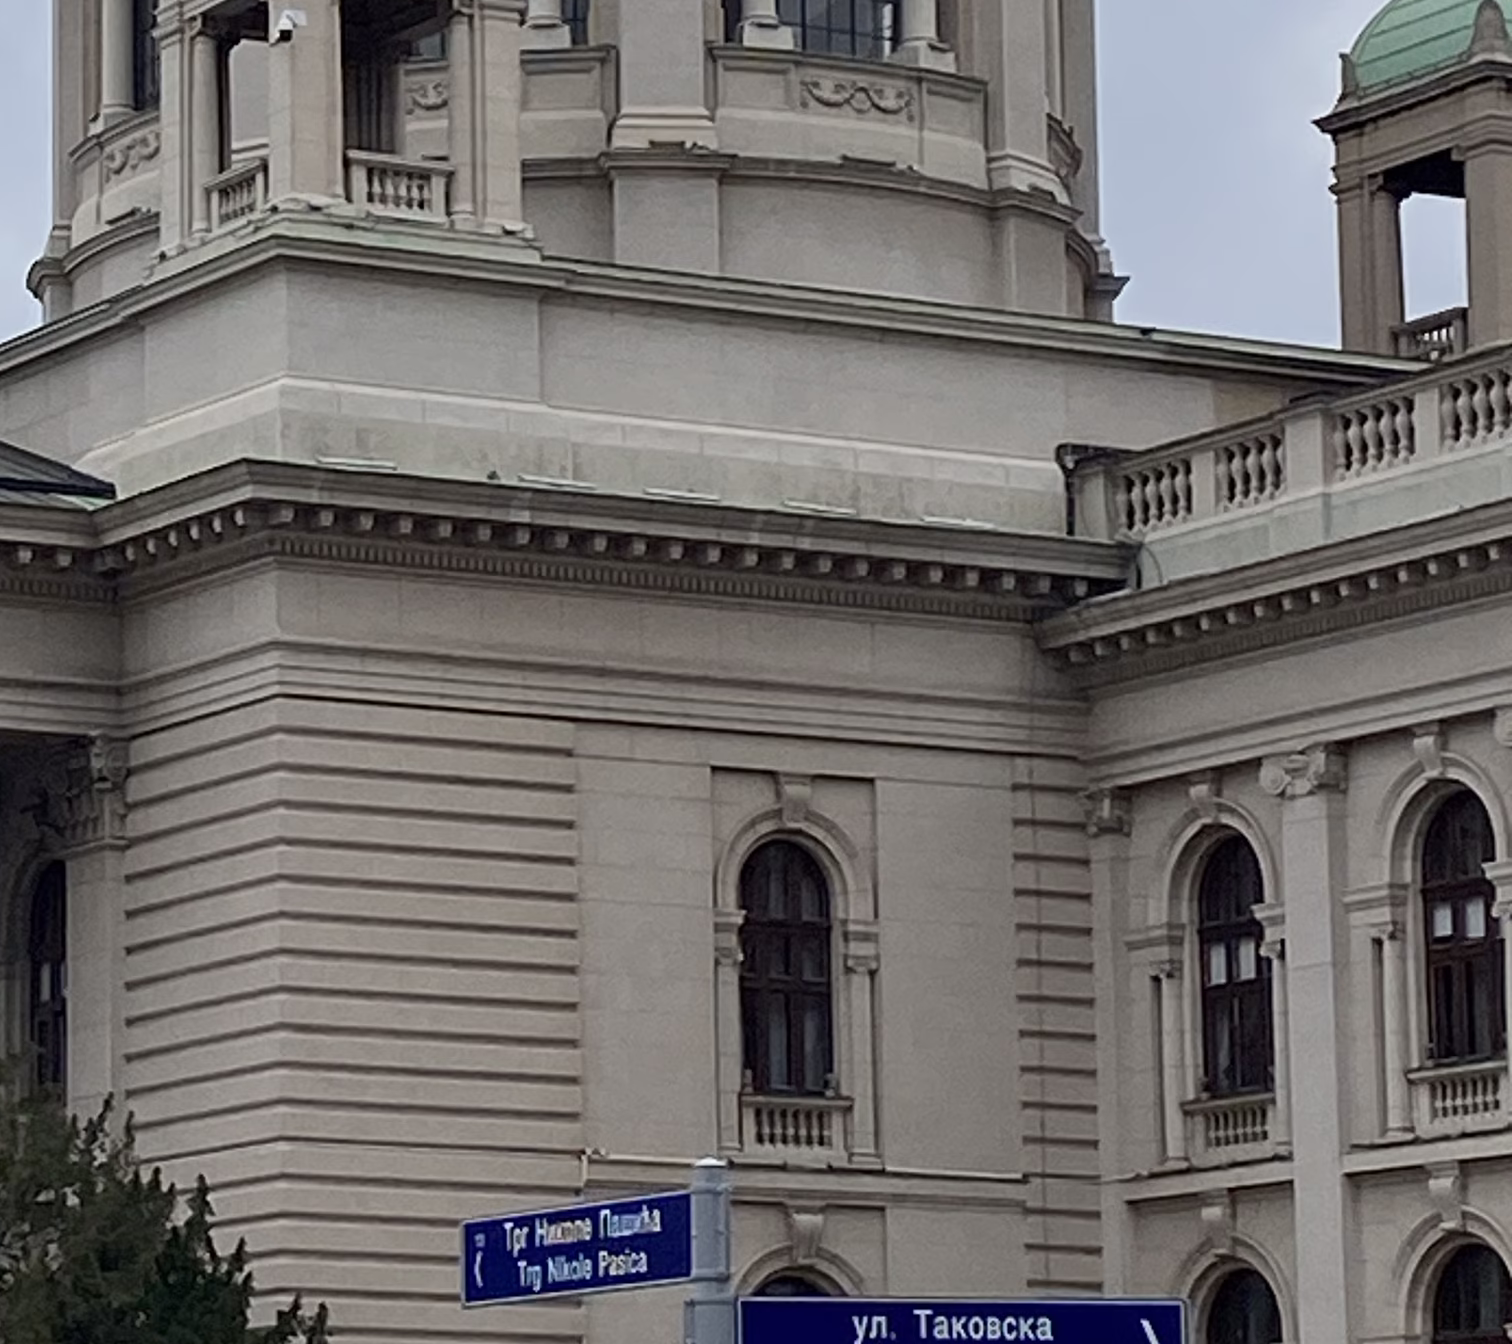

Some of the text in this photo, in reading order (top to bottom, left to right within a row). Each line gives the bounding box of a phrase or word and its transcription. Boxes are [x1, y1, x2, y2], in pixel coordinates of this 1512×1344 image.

[503, 1222, 529, 1258] Трг
[517, 1260, 542, 1293] Trg
[547, 1252, 592, 1284] Nikole
[913, 1309, 1054, 1341] Таковска
